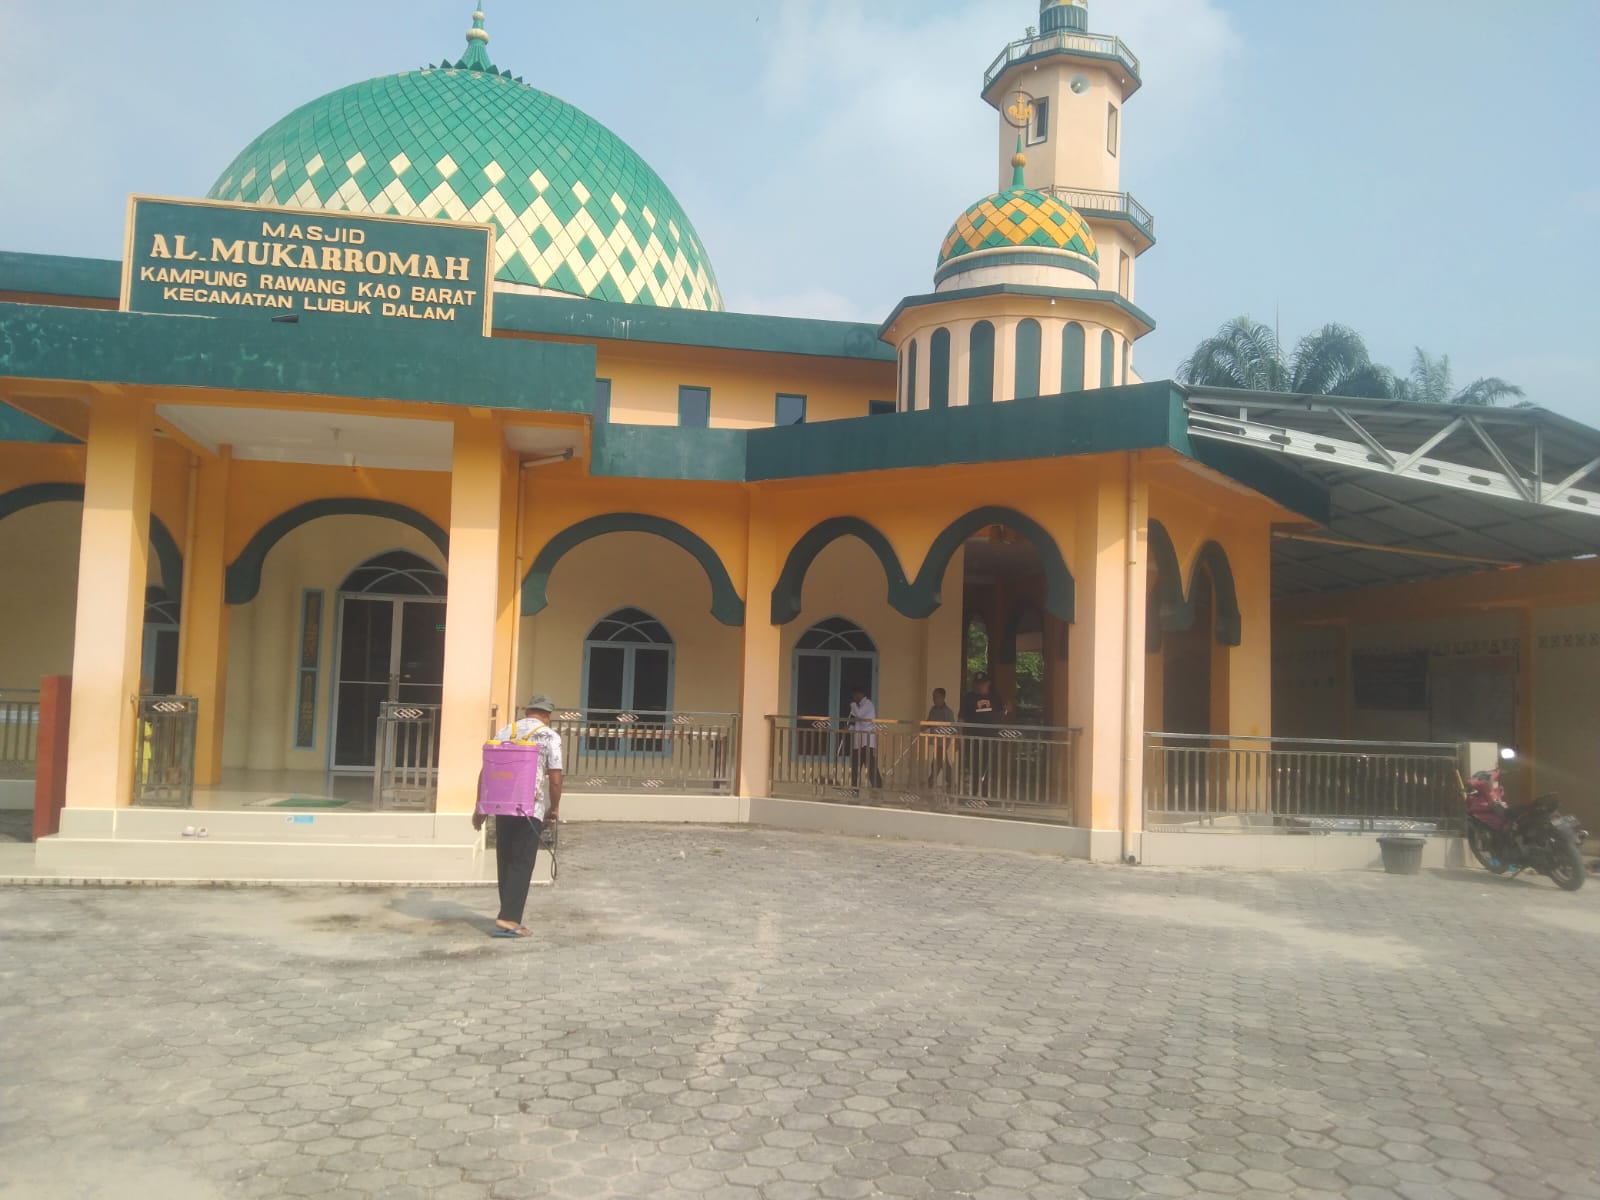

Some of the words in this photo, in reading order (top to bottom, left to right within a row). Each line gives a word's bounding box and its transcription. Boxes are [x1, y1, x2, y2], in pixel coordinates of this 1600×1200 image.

[262, 222, 365, 244] MASJID
[140, 266, 247, 288] KAMPUNG
[259, 274, 346, 296] RAWANG
[358, 281, 401, 300] KAO
[411, 286, 477, 306] BARAT
[163, 287, 293, 309] KECAMATAN
[303, 297, 372, 315] LUBUK
[382, 302, 455, 321] DALAM
